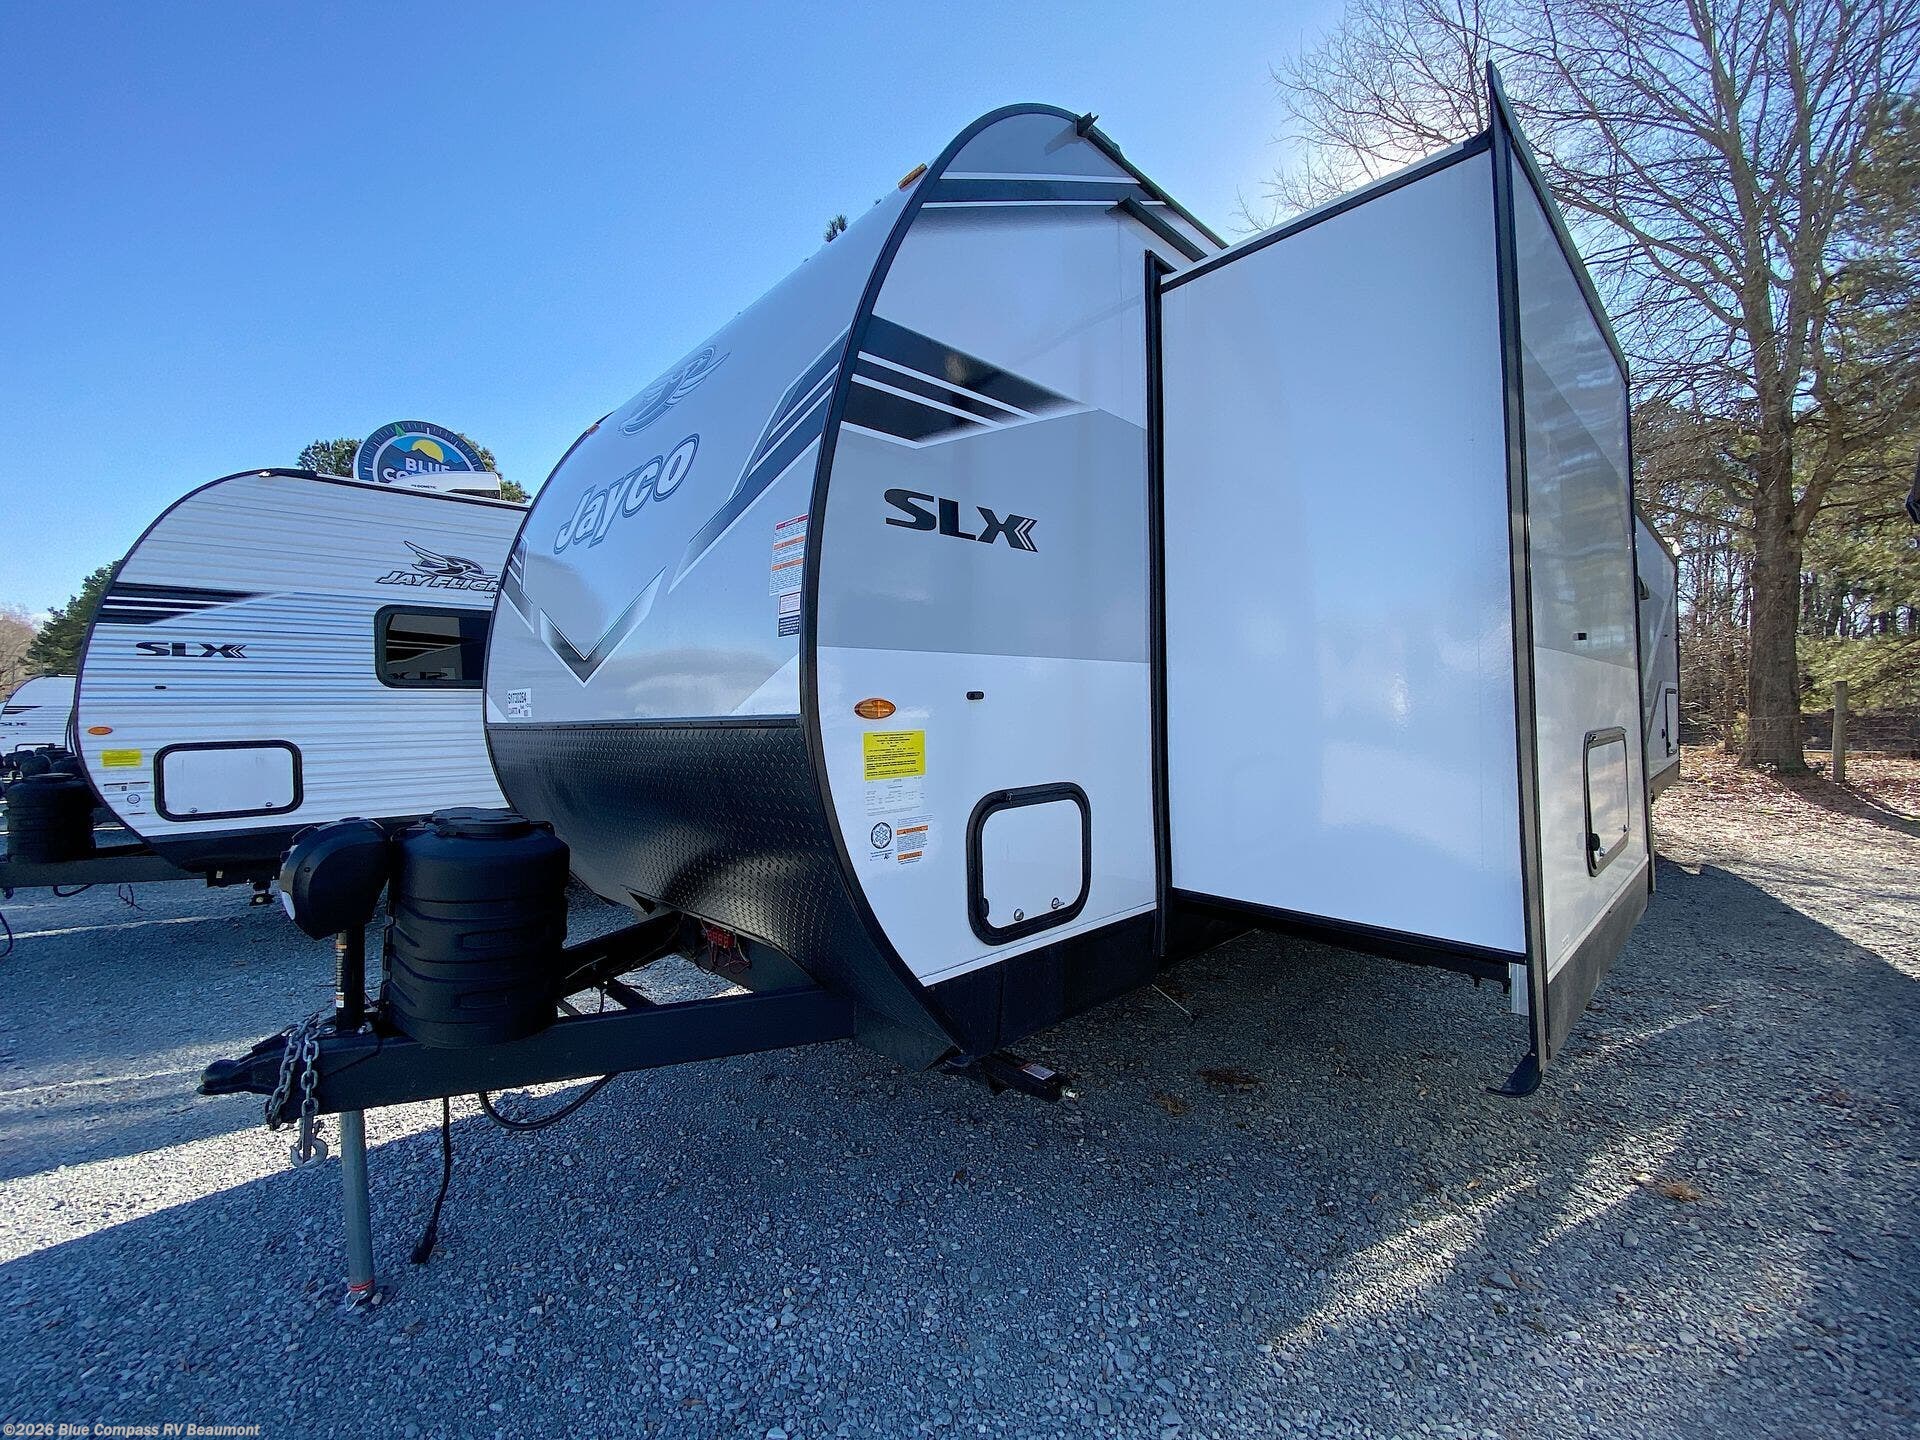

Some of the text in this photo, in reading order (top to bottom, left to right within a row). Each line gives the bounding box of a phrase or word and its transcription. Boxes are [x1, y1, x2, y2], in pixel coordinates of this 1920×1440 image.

[554, 433, 700, 555] Jayco
[884, 488, 1039, 553] SLX
[375, 570, 500, 592] JAY FLIGH
[135, 641, 248, 659] SLX
